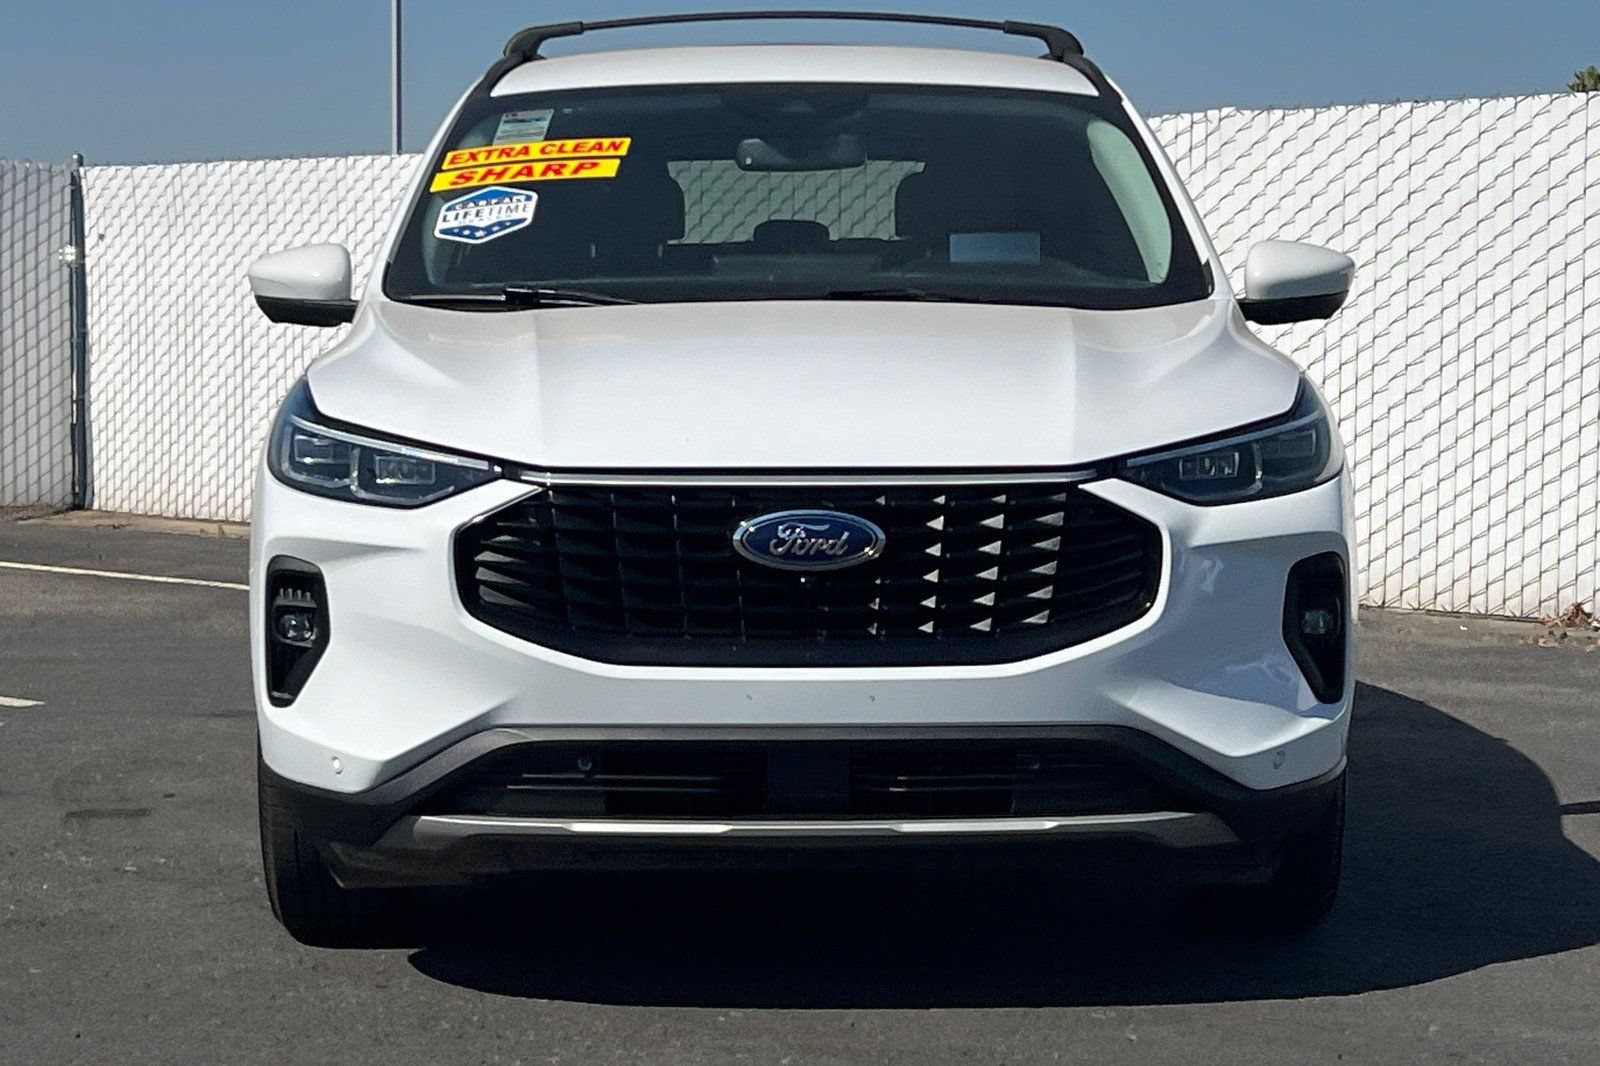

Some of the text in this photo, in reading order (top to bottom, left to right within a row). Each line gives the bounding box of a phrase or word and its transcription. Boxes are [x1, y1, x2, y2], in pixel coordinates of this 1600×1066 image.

[448, 139, 625, 166] EXTRA CLEAN
[448, 161, 601, 187] SHARP
[441, 203, 531, 223] LIFETIME
[769, 521, 850, 556] Ford
